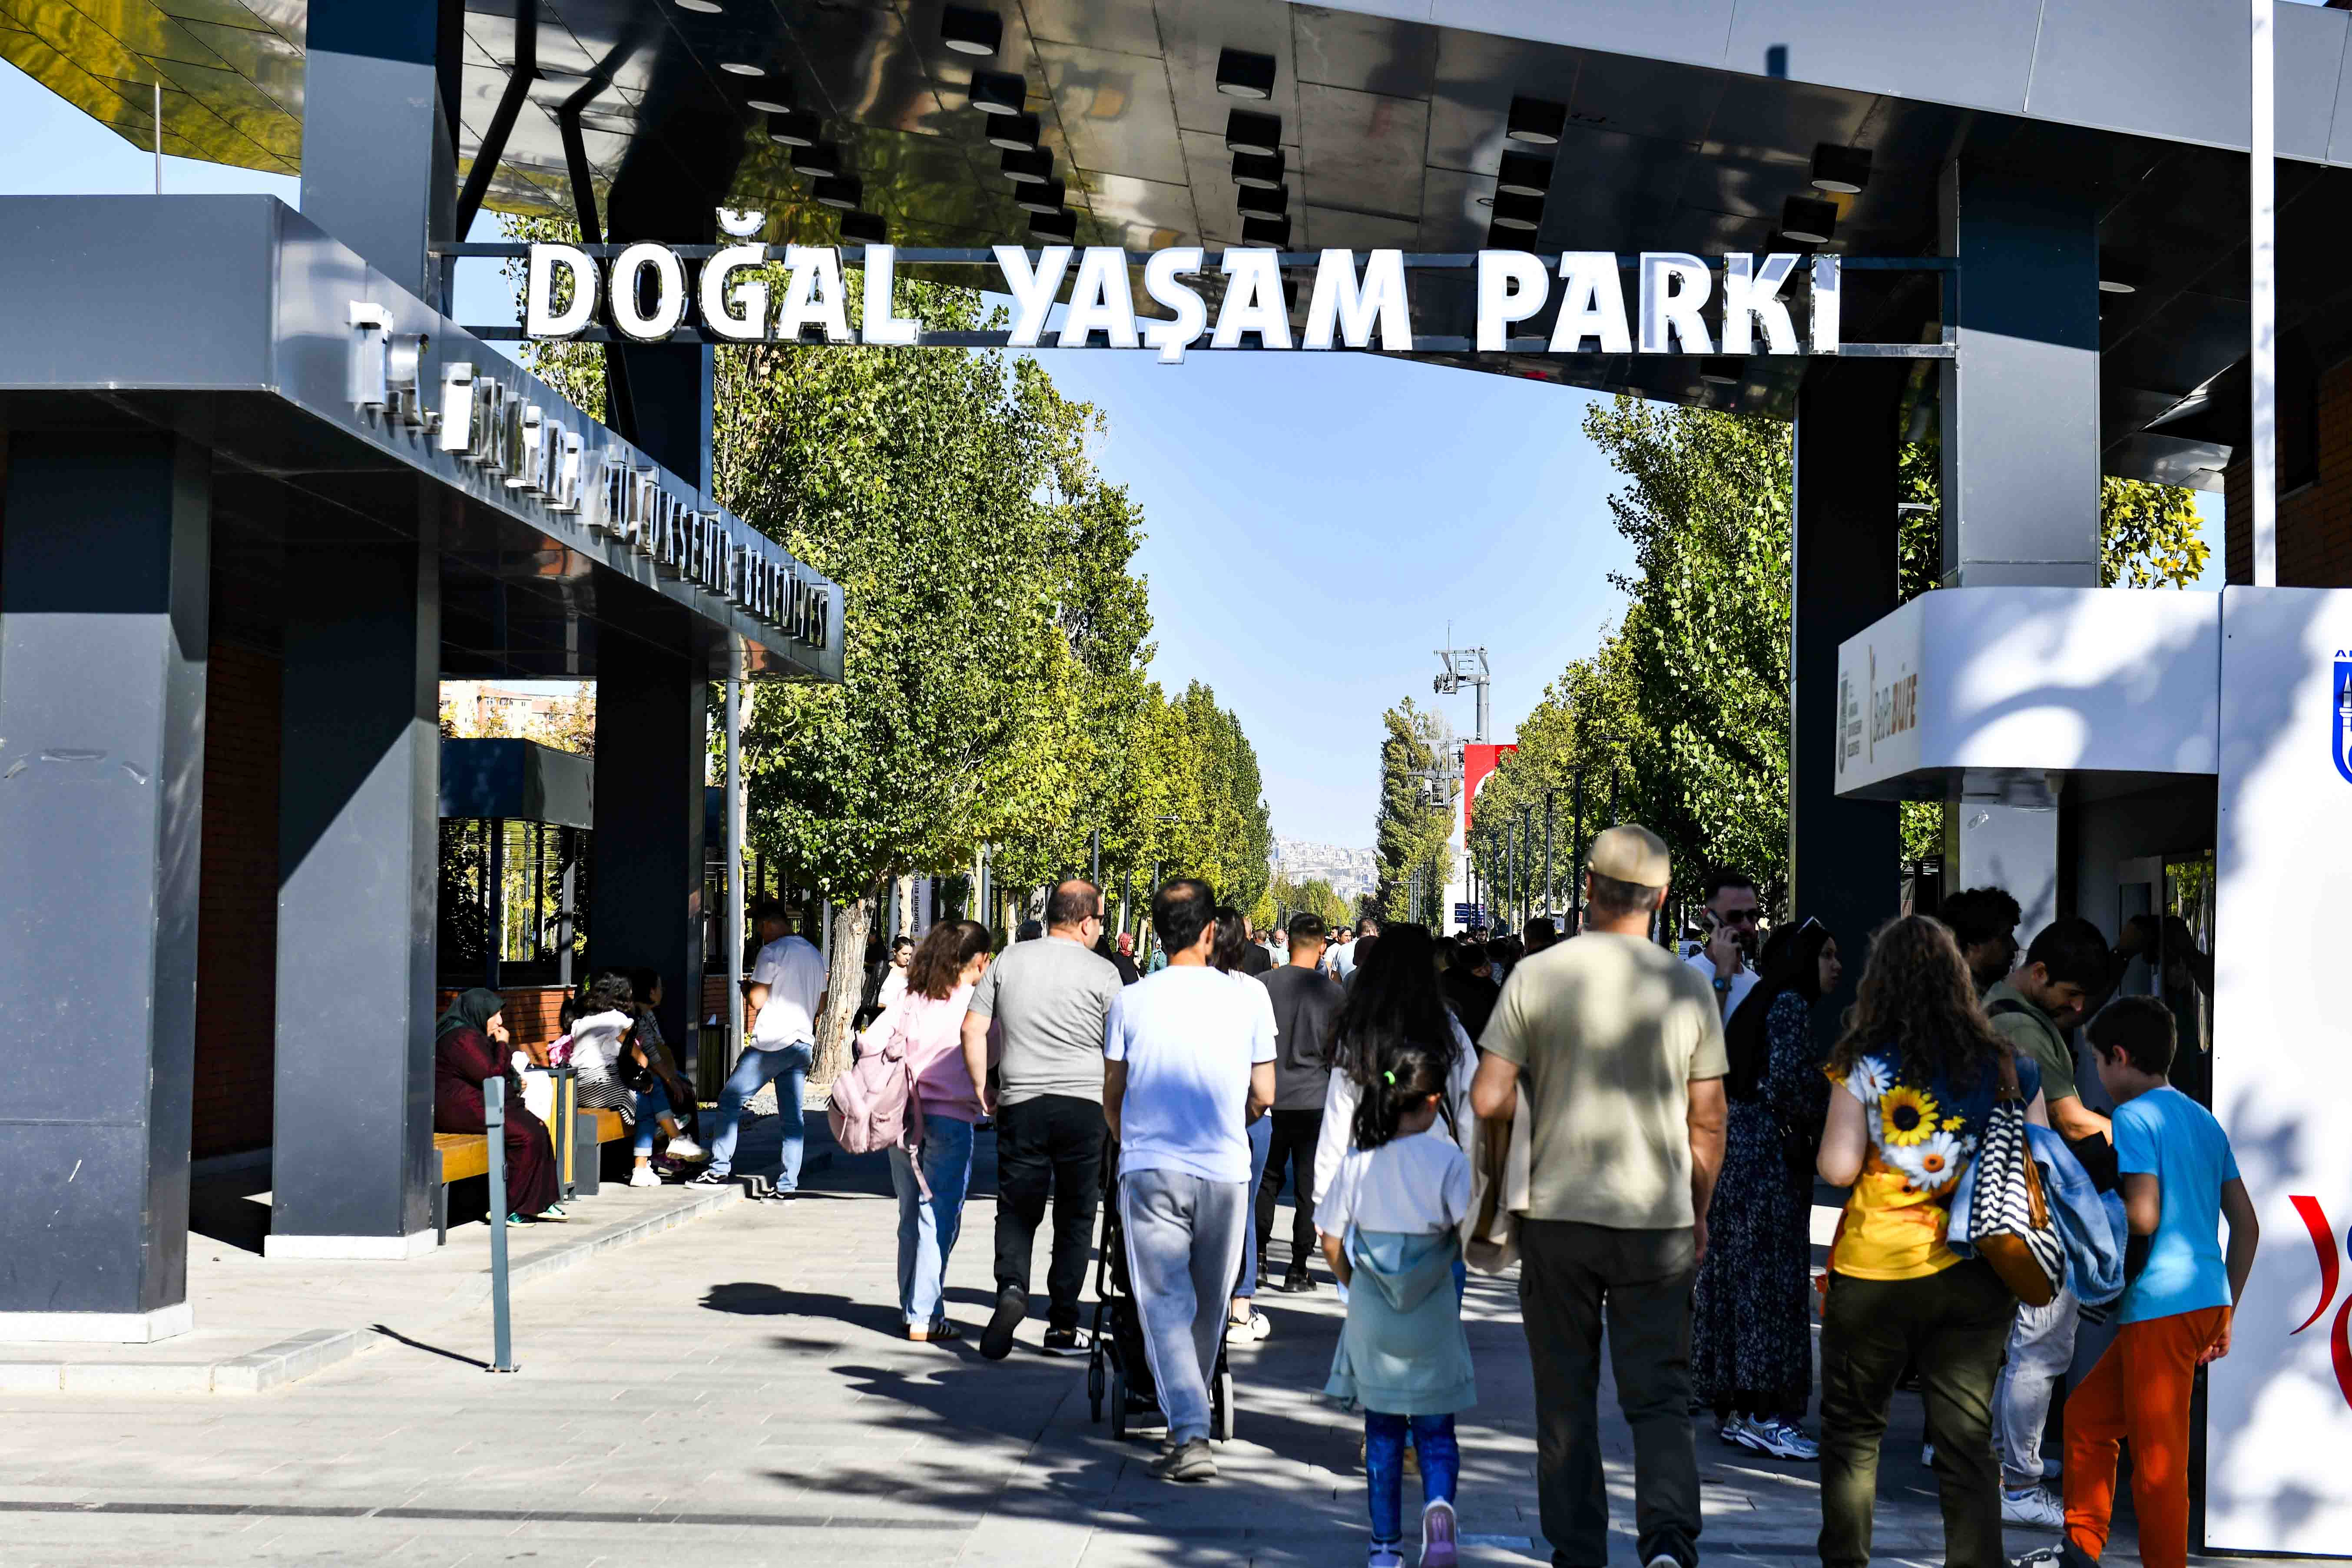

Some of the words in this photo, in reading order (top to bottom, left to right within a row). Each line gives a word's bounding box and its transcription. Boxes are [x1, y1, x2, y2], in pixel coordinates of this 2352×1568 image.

[526, 206, 922, 346] DOĞAL
[992, 244, 1413, 365] YAŞAM
[1477, 249, 1841, 355] PARKI
